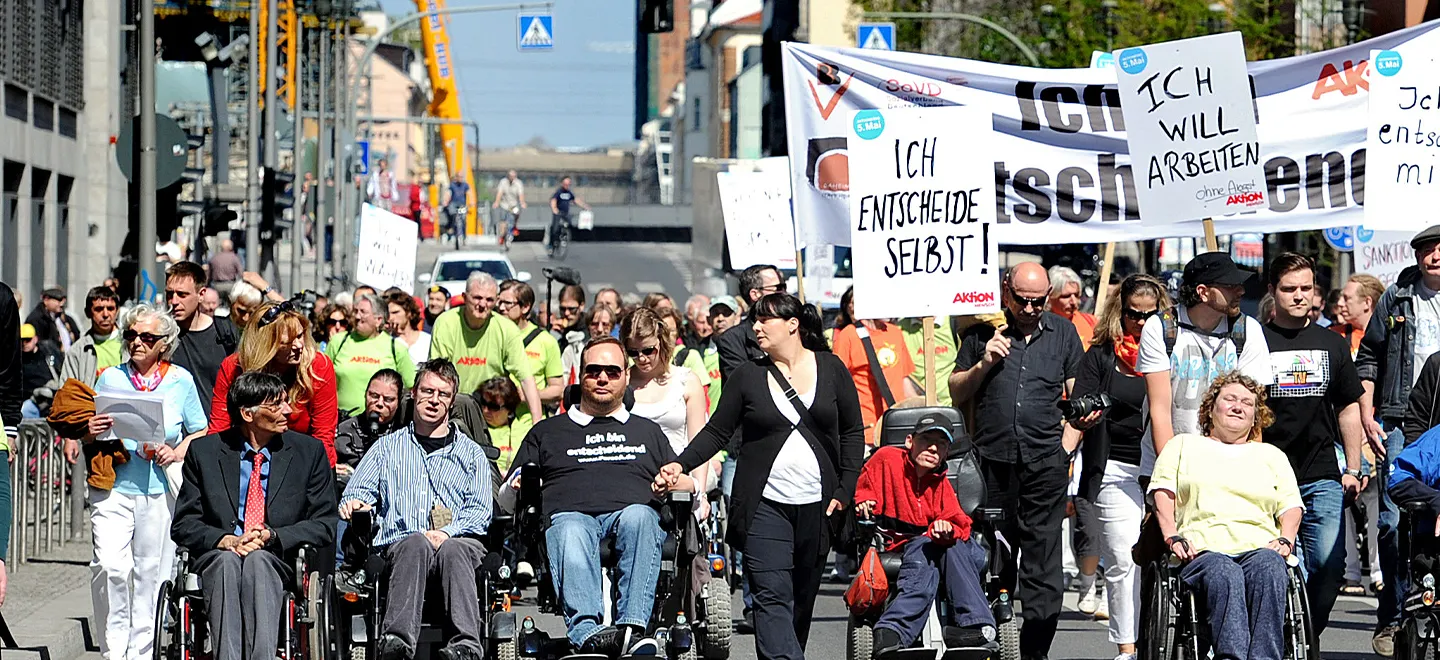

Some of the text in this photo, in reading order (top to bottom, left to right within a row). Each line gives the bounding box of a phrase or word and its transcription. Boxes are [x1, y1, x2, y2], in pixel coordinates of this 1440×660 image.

[1137, 66, 1213, 113] ICH
[1159, 106, 1239, 142] WILL
[895, 137, 938, 179] ICH
[1148, 141, 1260, 189] ARBEITEN
[858, 188, 982, 232] ENTSCHEIDE
[1196, 185, 1224, 200] ohne
[566, 444, 646, 456] entscheidend
[585, 432, 627, 444] Ich bin
